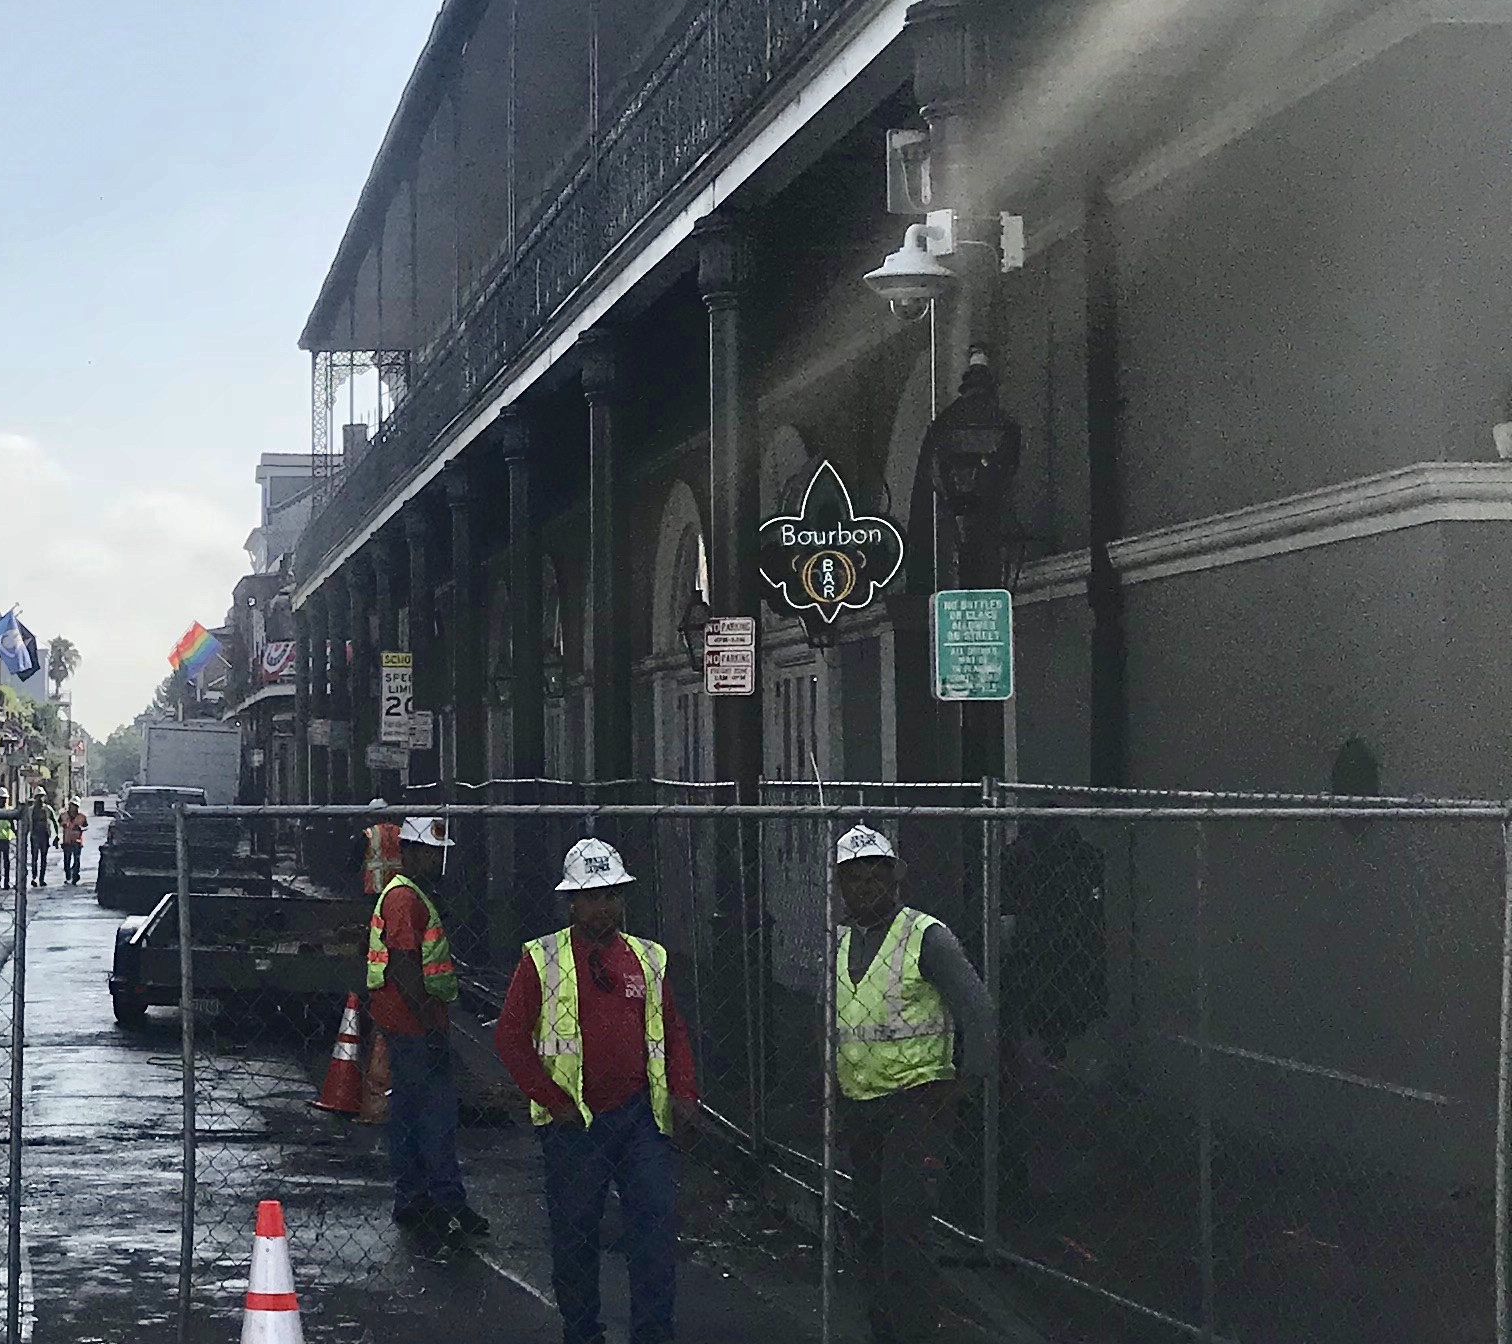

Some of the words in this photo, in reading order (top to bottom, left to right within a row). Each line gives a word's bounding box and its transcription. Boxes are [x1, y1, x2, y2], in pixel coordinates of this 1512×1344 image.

[782, 521, 882, 546] Bourbon
[822, 558, 835, 598] BAR
[706, 623, 720, 633] NO
[384, 655, 411, 664] SCHO
[706, 655, 720, 664] NO
[388, 685, 411, 694] LIMI
